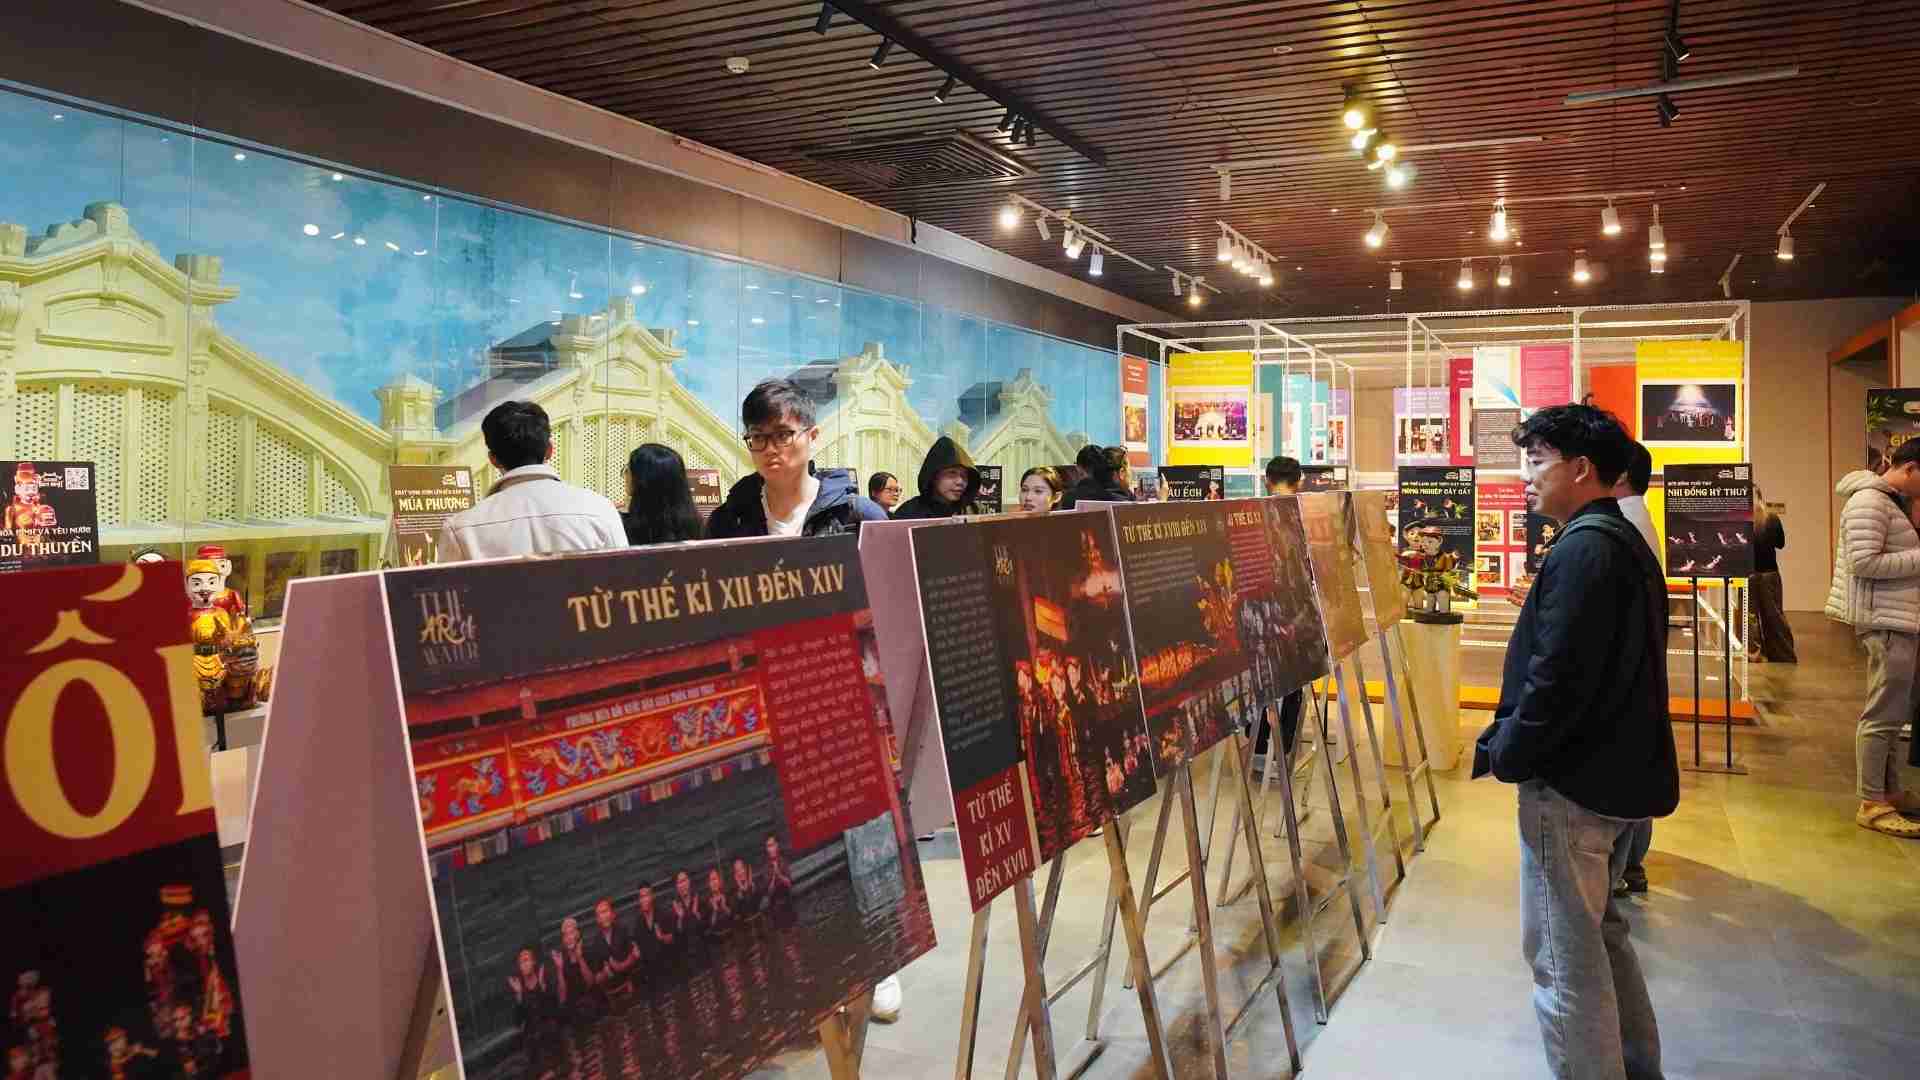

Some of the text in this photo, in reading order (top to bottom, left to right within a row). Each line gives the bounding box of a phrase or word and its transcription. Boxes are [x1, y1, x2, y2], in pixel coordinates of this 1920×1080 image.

[399, 495, 423, 511] MÚA
[1667, 488, 1682, 497] NHI
[1684, 485, 1708, 497] ĐỒNG
[1122, 519, 1136, 544] TỪ
[1136, 515, 1153, 543] THẾ
[0, 535, 92, 557] DU THUYỀN
[567, 557, 845, 633] TỪ THẾ KỈ XII ĐẾN XIV
[966, 770, 1015, 825] TỪ THẾ
[995, 818, 1012, 849] XV
[975, 847, 1029, 901] ĐẾN XVII
